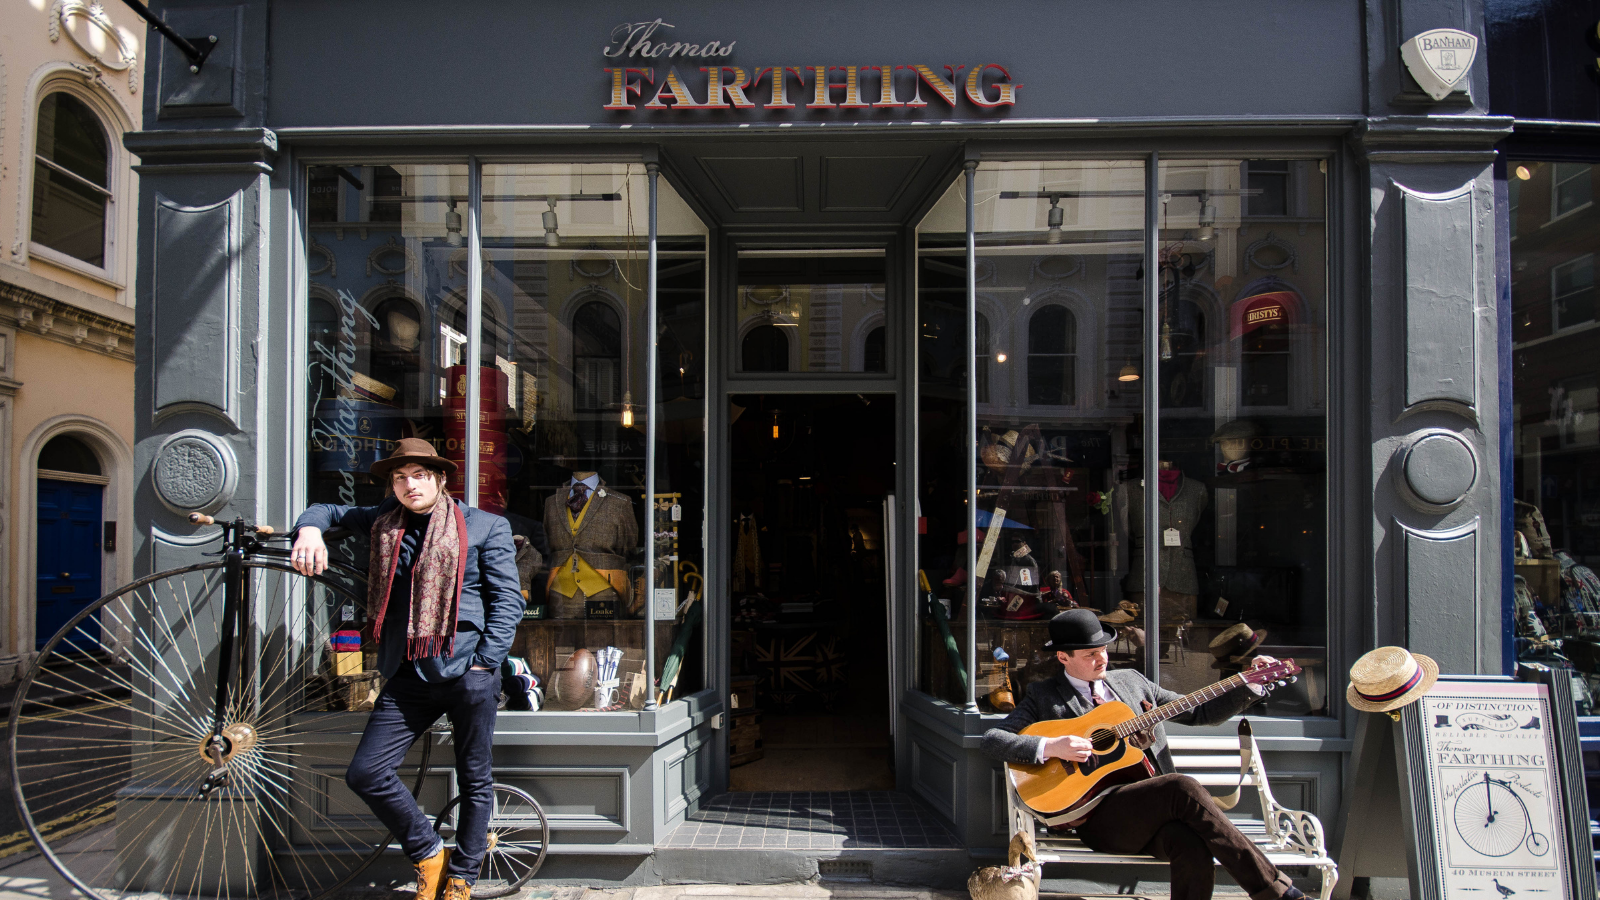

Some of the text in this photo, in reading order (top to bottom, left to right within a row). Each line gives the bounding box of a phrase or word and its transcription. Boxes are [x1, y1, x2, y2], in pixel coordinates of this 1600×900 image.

[603, 17, 736, 58] Thomas
[1422, 38, 1471, 51] BANHAM
[603, 63, 1025, 111] FARTHING
[308, 288, 380, 459] Farthing
[590, 607, 614, 615] Loake
[1462, 716, 1514, 728] SUPPLIERS
[1436, 740, 1471, 752] Thomas
[1436, 752, 1545, 766] FARTHING
[1503, 770, 1545, 799] Products
[1468, 869, 1514, 877] MUSEUM
